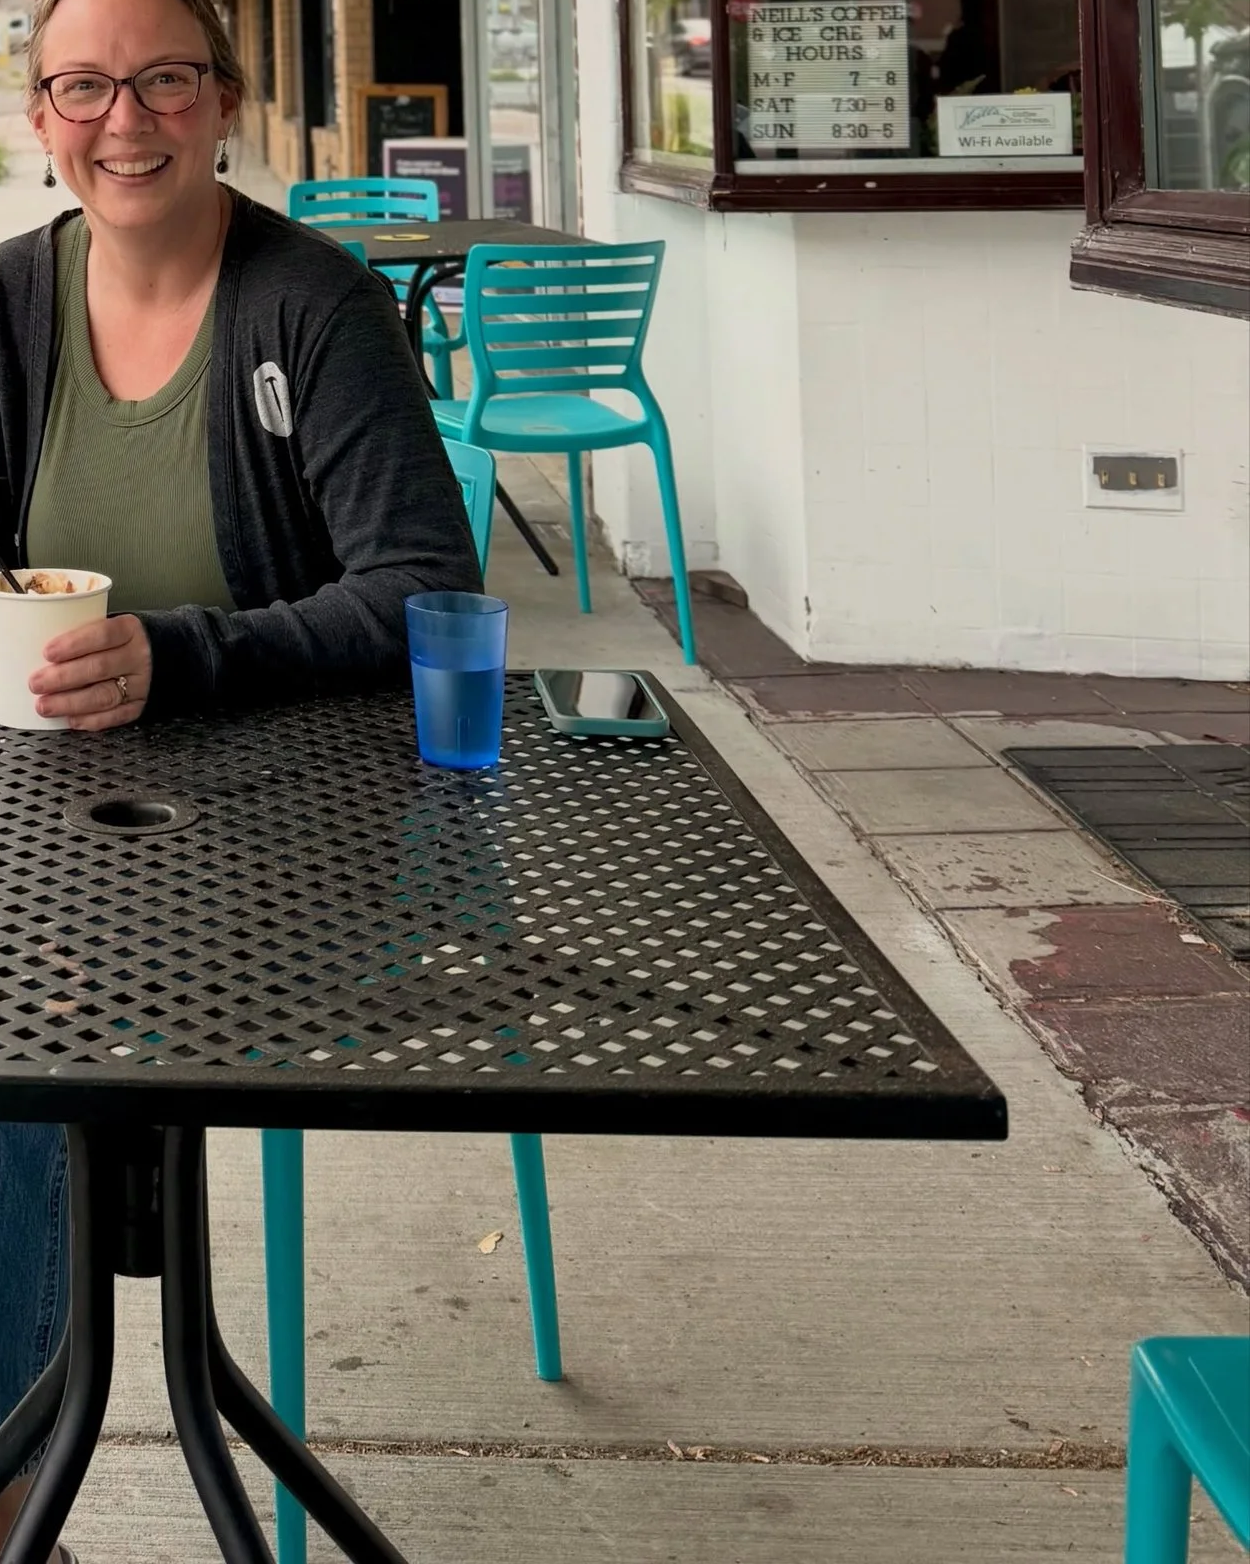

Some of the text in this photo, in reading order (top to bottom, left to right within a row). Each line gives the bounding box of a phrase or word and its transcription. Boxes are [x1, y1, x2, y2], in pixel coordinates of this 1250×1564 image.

[752, 7, 824, 24] NEILL'S
[831, 5, 905, 22] COFFEE
[772, 27, 802, 43] ICE
[785, 45, 864, 61] HOURS
[752, 97, 795, 113] SAT
[752, 123, 795, 139] SUN
[958, 134, 1053, 148] Wi-Fi Available
